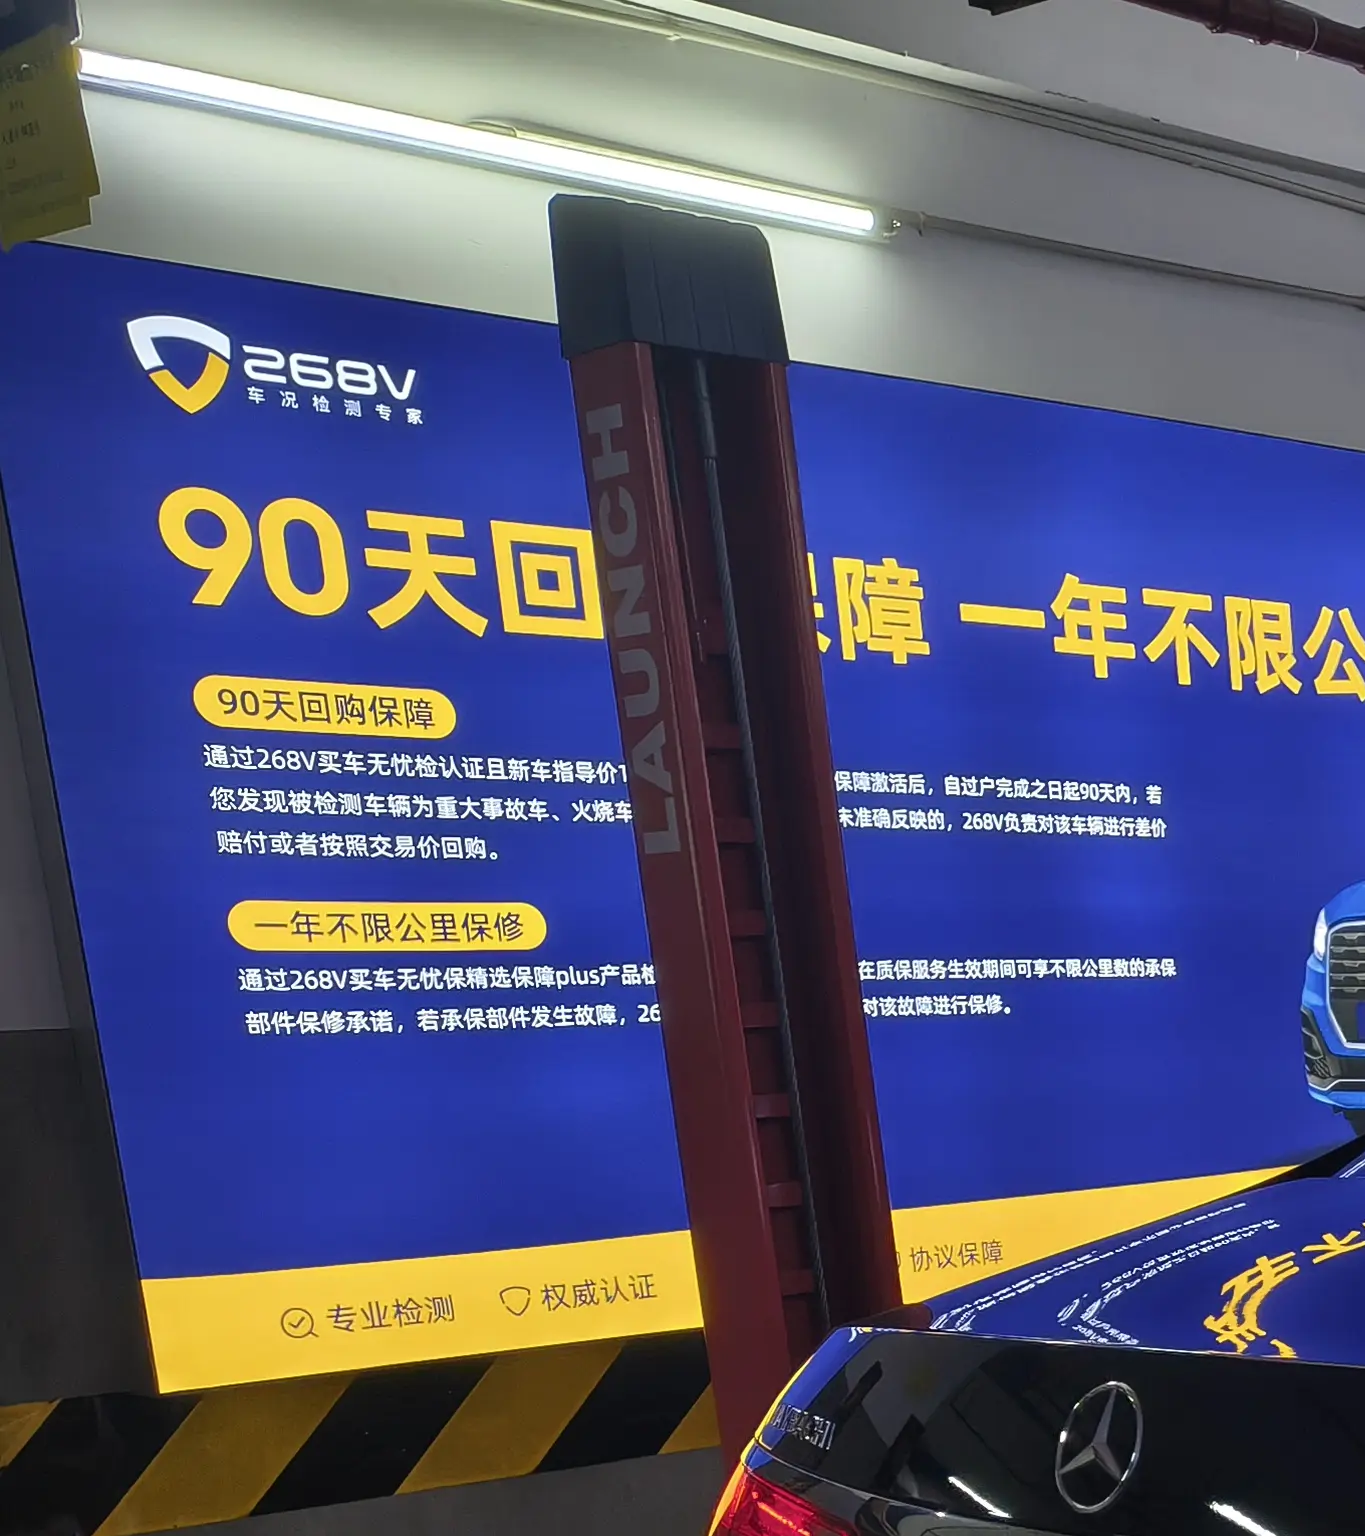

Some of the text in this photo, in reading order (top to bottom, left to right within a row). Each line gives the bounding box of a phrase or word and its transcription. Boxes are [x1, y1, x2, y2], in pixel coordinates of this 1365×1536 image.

[242, 345, 416, 400] 268V
[247, 386, 423, 425] 车况检测专家
[586, 402, 682, 855] LAUNCH
[217, 688, 436, 730] 90天回购保障
[253, 910, 525, 944] 一年不限公里保修
[326, 1238, 1004, 1333] 专业检测 权威认证 协议保障
